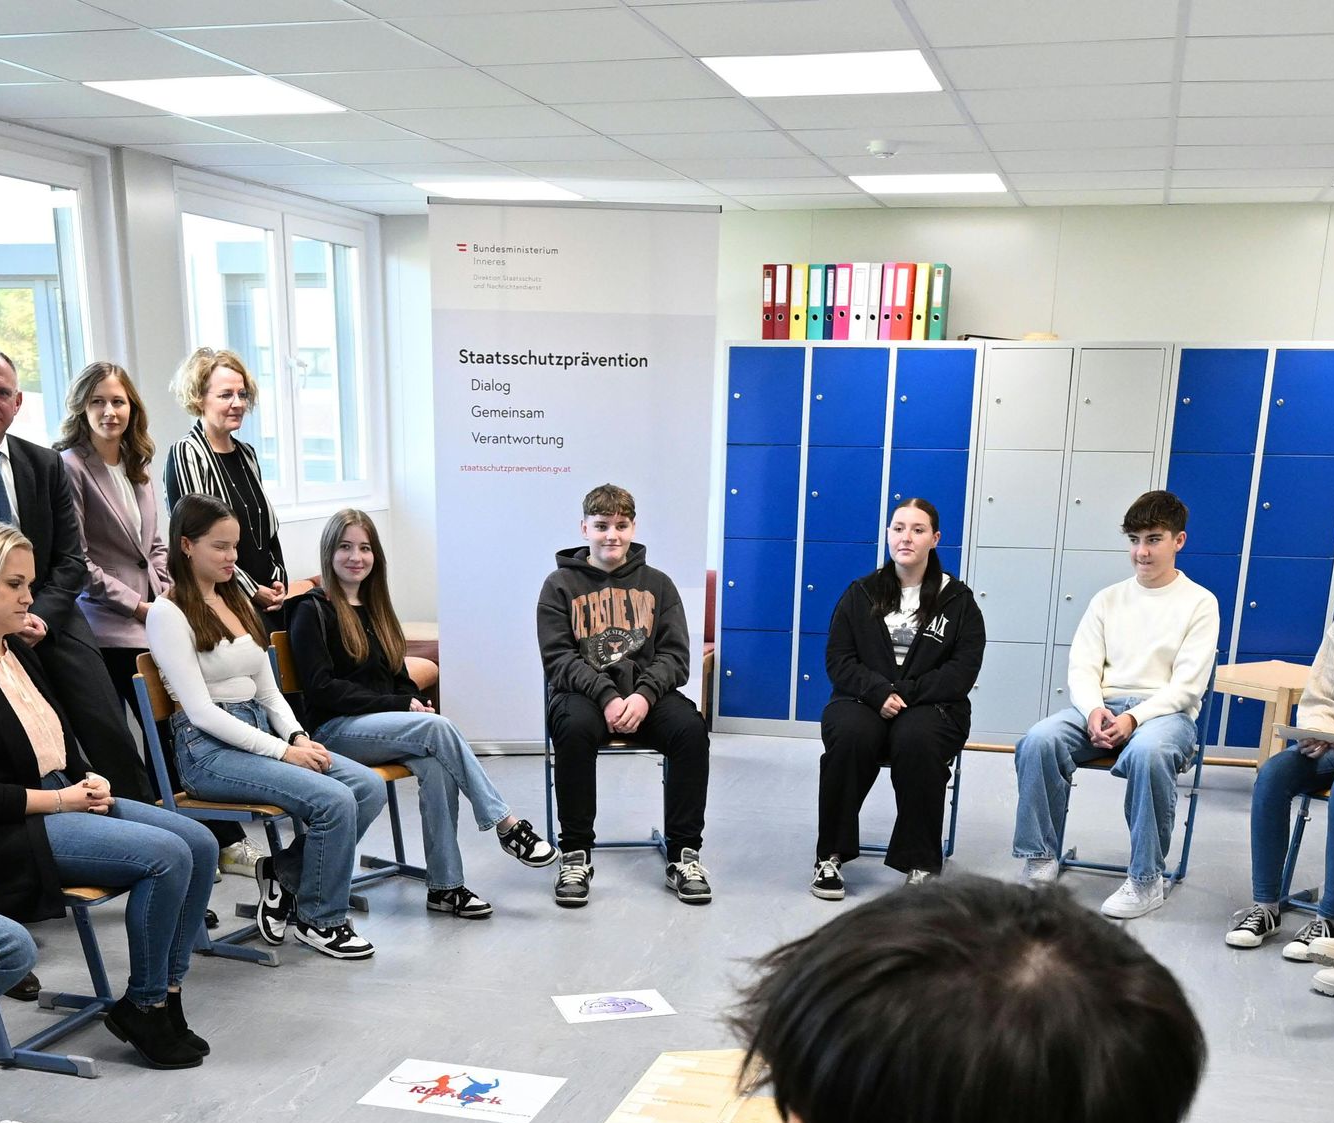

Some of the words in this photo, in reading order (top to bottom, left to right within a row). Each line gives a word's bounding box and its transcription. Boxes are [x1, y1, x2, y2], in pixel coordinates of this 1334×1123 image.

[473, 243, 559, 255] Bundesministerium
[473, 257, 506, 266] Inneres
[459, 349, 649, 370] Staatsschutzprävention
[471, 379, 511, 395] Dialog
[471, 405, 545, 419] Gemeinsam
[471, 431, 564, 449] Verantwortung
[460, 464, 571, 475] staatsschutzpraevention.gv.at
